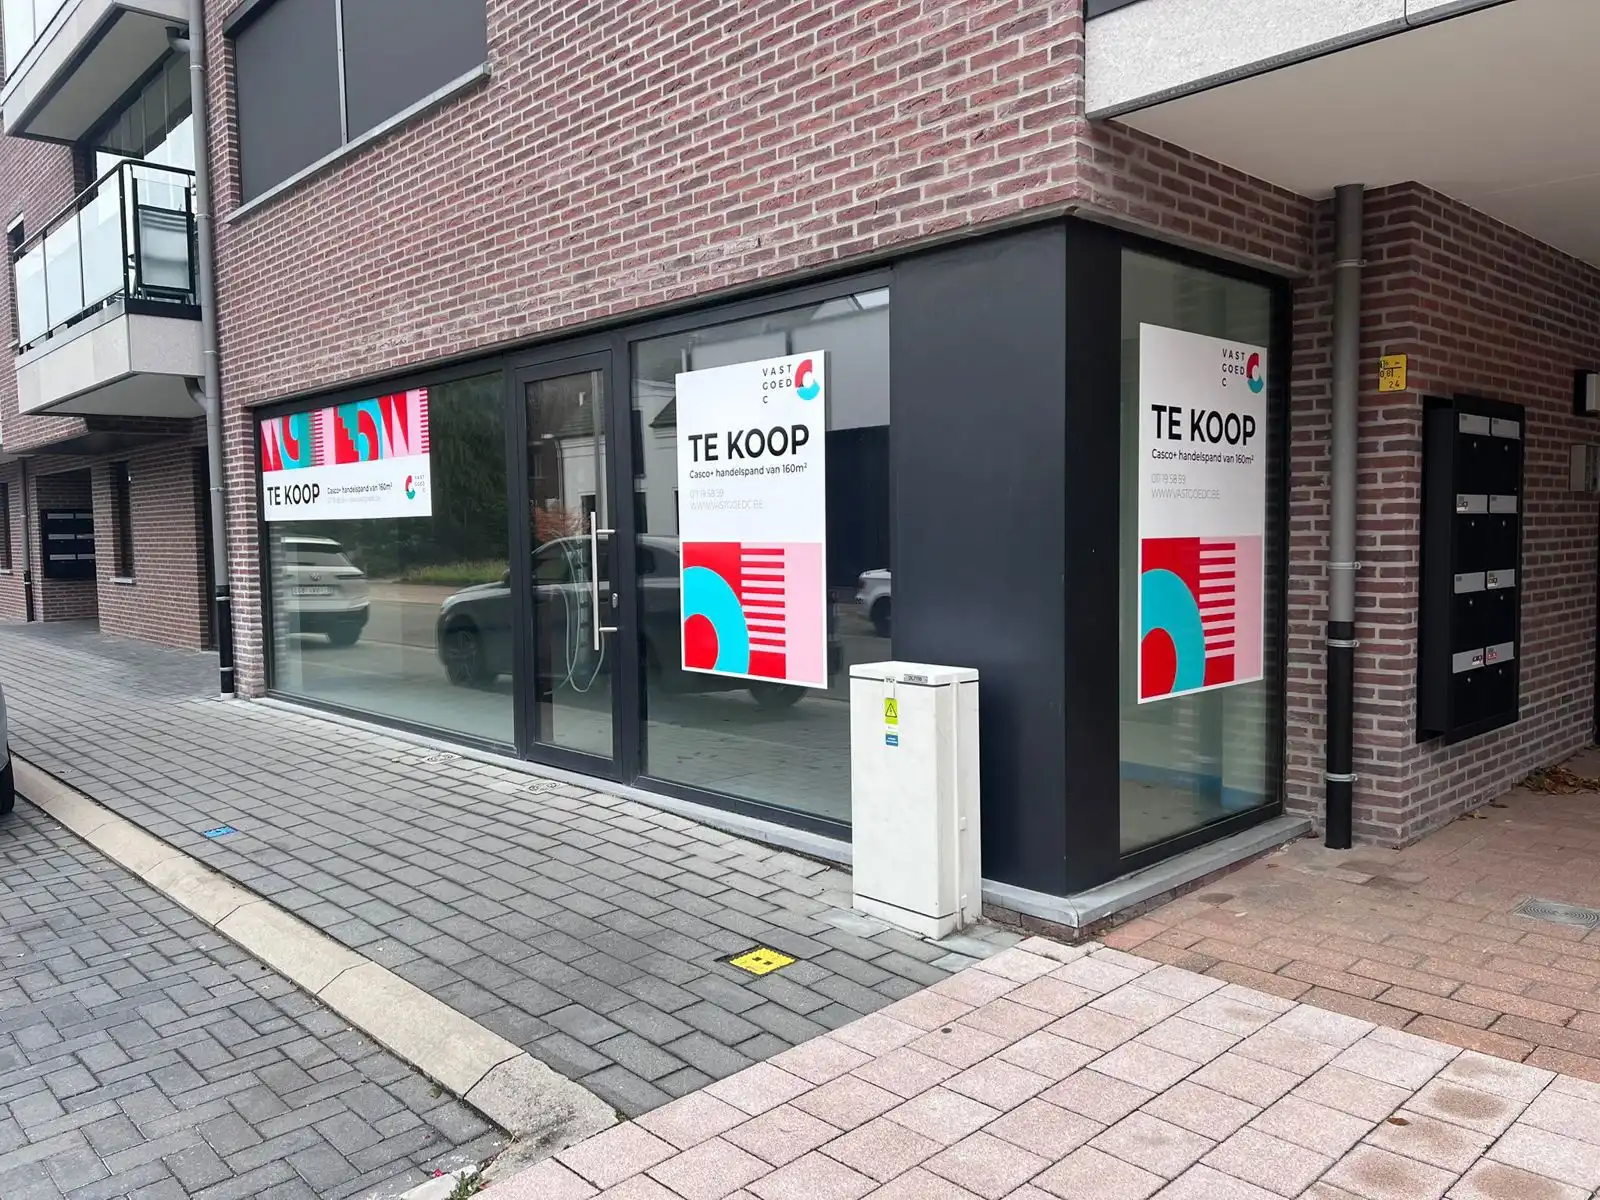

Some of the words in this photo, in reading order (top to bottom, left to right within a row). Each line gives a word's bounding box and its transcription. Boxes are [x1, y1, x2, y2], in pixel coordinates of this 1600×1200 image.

[1222, 348, 1246, 361] VAST
[762, 364, 792, 377] VAST
[1222, 363, 1245, 375] GOED
[762, 378, 792, 390] GOED
[1222, 378, 1227, 387] C
[762, 396, 768, 404] C
[1151, 404, 1182, 440] TE
[1190, 409, 1256, 446] KOOP
[688, 433, 718, 462] TE
[727, 424, 809, 459] KOOP
[1152, 448, 1176, 460] Casco+
[1179, 450, 1221, 463] handelspand
[1223, 455, 1234, 463] van
[689, 470, 714, 479] Casco+
[716, 466, 764, 478] handelspand
[766, 465, 780, 474] van
[267, 486, 281, 505] TE
[285, 483, 320, 505] KOOP
